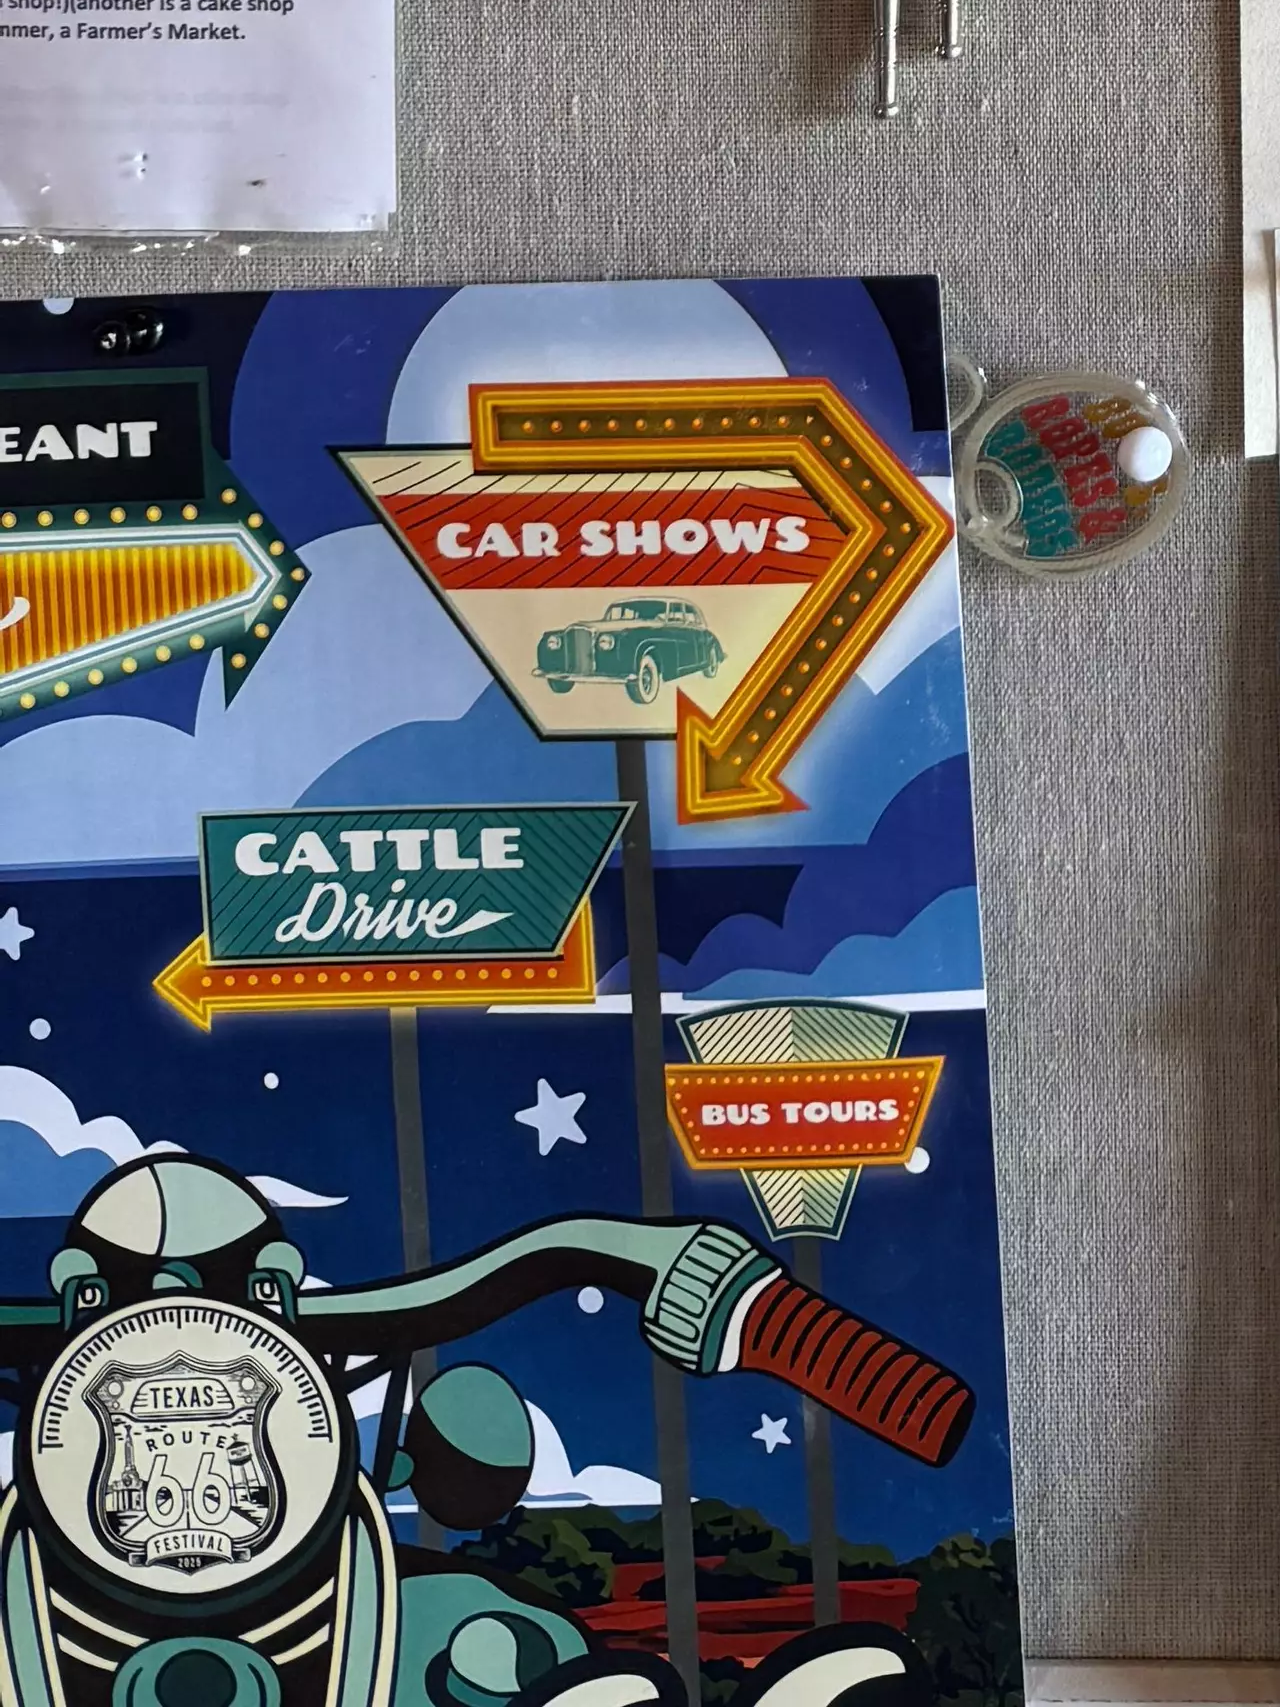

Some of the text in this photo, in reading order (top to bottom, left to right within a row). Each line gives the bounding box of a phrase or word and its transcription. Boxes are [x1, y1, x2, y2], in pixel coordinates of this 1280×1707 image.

[59, 21, 246, 40] a Farmer's Market.
[436, 515, 811, 560] CAR SHOWS
[234, 826, 523, 877] CATTLE
[275, 877, 513, 944] Drive
[700, 1096, 898, 1126] BUS TOURS
[150, 1385, 215, 1410] TEXAS
[145, 1431, 228, 1453] ROUTE
[145, 1451, 232, 1528] 66
[153, 1535, 224, 1555] FESTIVAL
